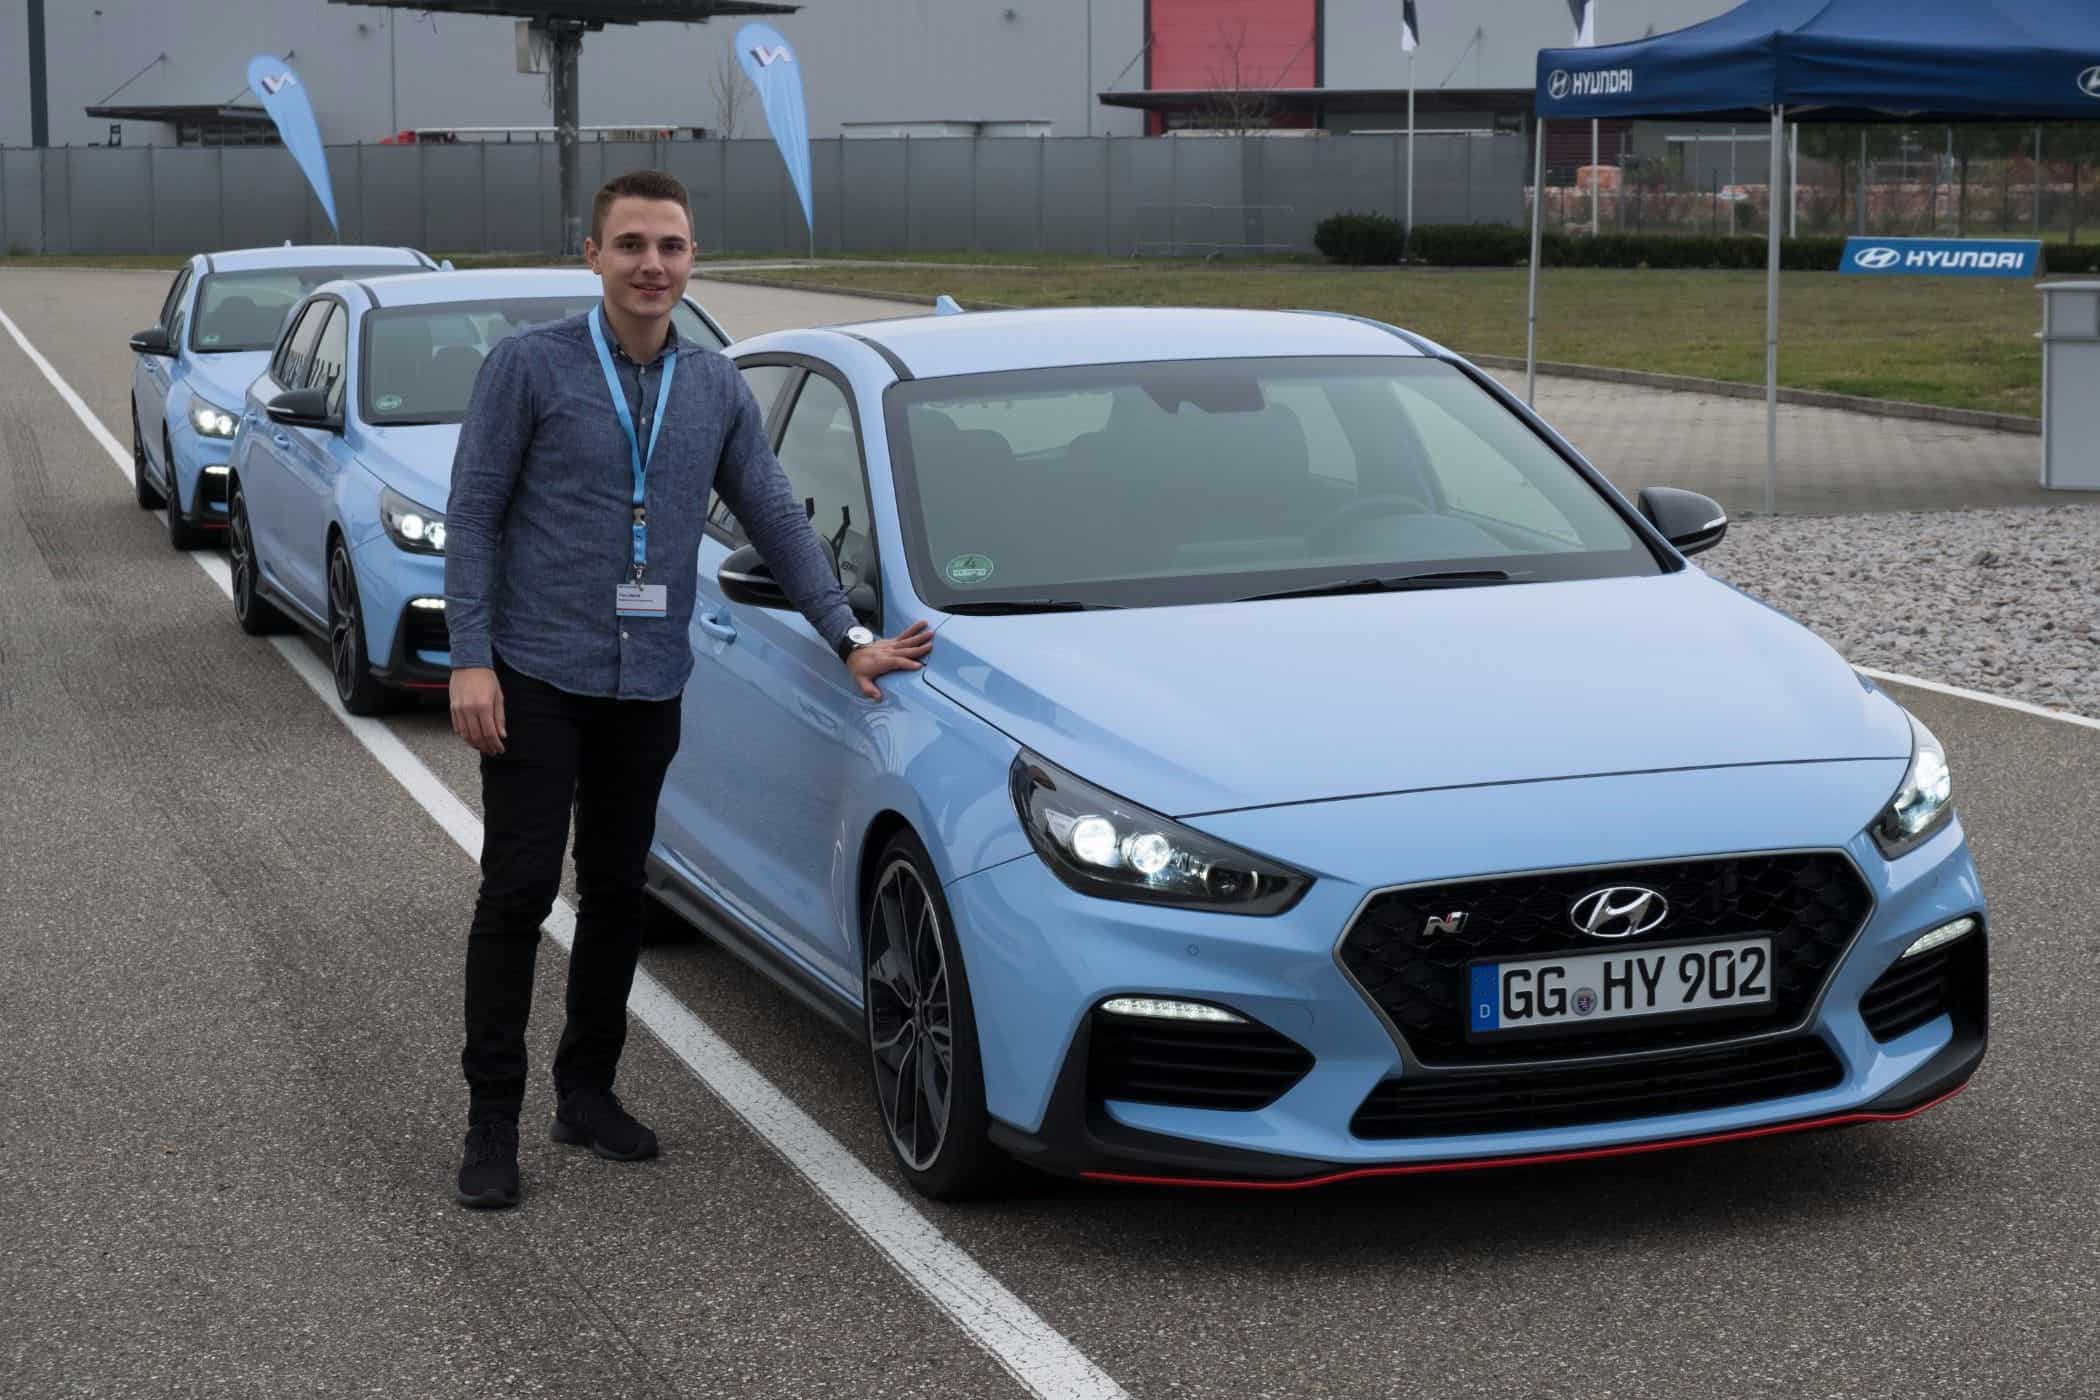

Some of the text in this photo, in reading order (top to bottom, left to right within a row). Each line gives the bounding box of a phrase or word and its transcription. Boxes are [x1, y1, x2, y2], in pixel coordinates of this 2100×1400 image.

[1572, 69, 1632, 95] HYUNDAI
[1905, 250, 2025, 268] HYUNDAI
[1480, 947, 1766, 1020] D GG HY 902
